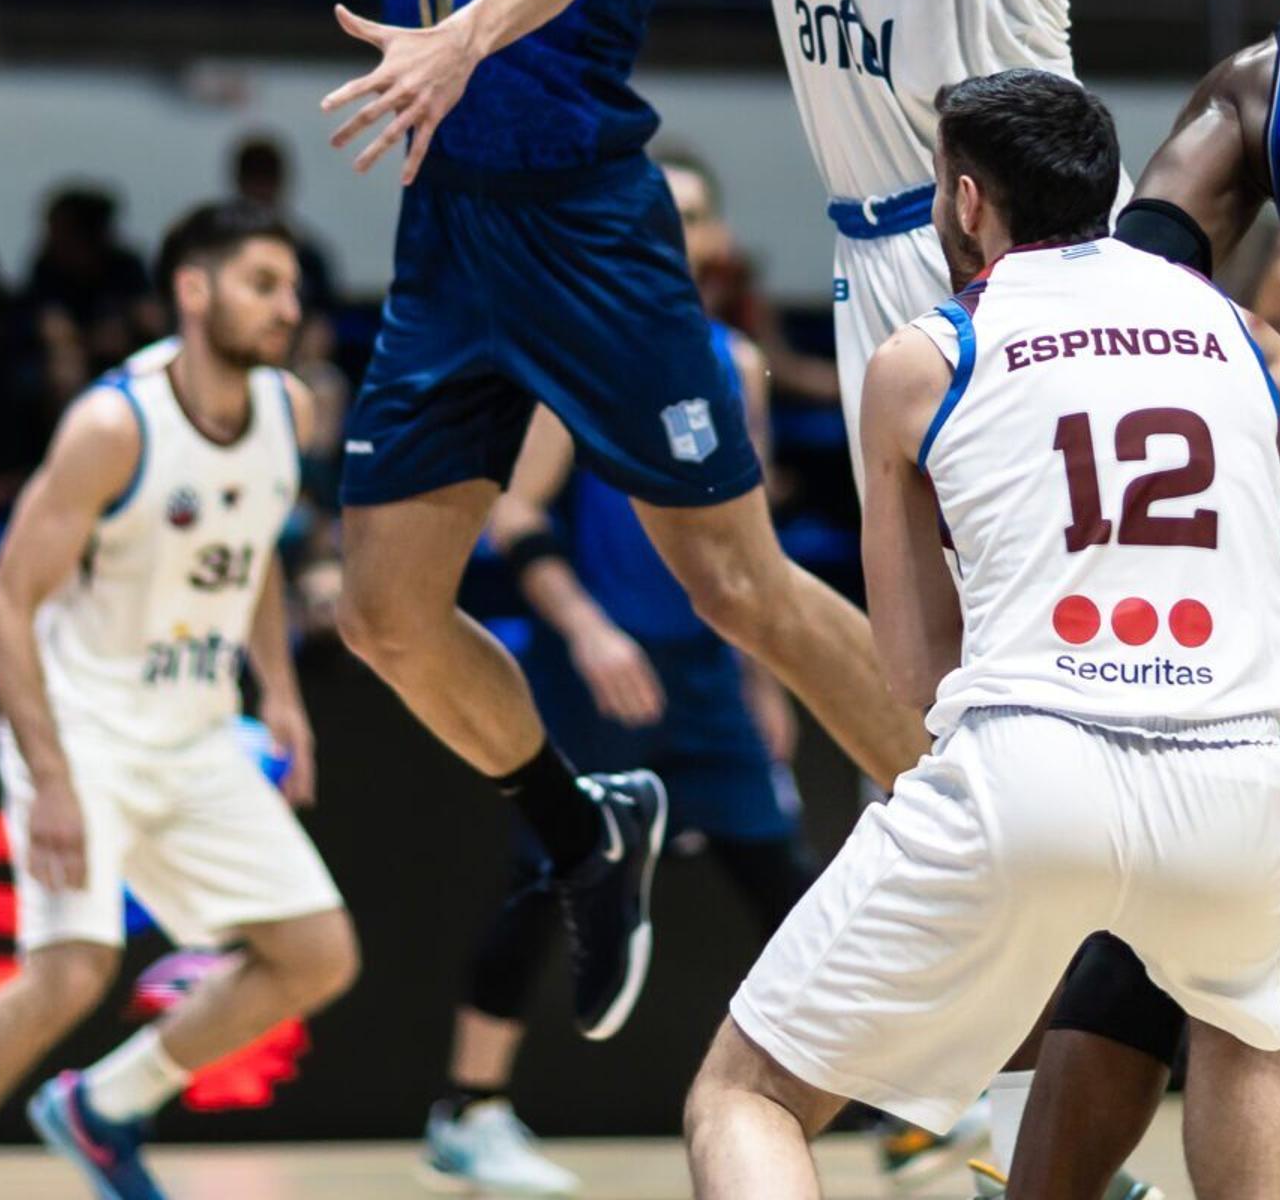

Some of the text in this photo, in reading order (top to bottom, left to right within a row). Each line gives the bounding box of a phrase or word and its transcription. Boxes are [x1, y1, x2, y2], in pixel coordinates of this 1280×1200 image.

[1005, 327, 1228, 373] ESPINOSA
[1053, 406, 1219, 553] 12
[1055, 654, 1214, 686] Securitas
